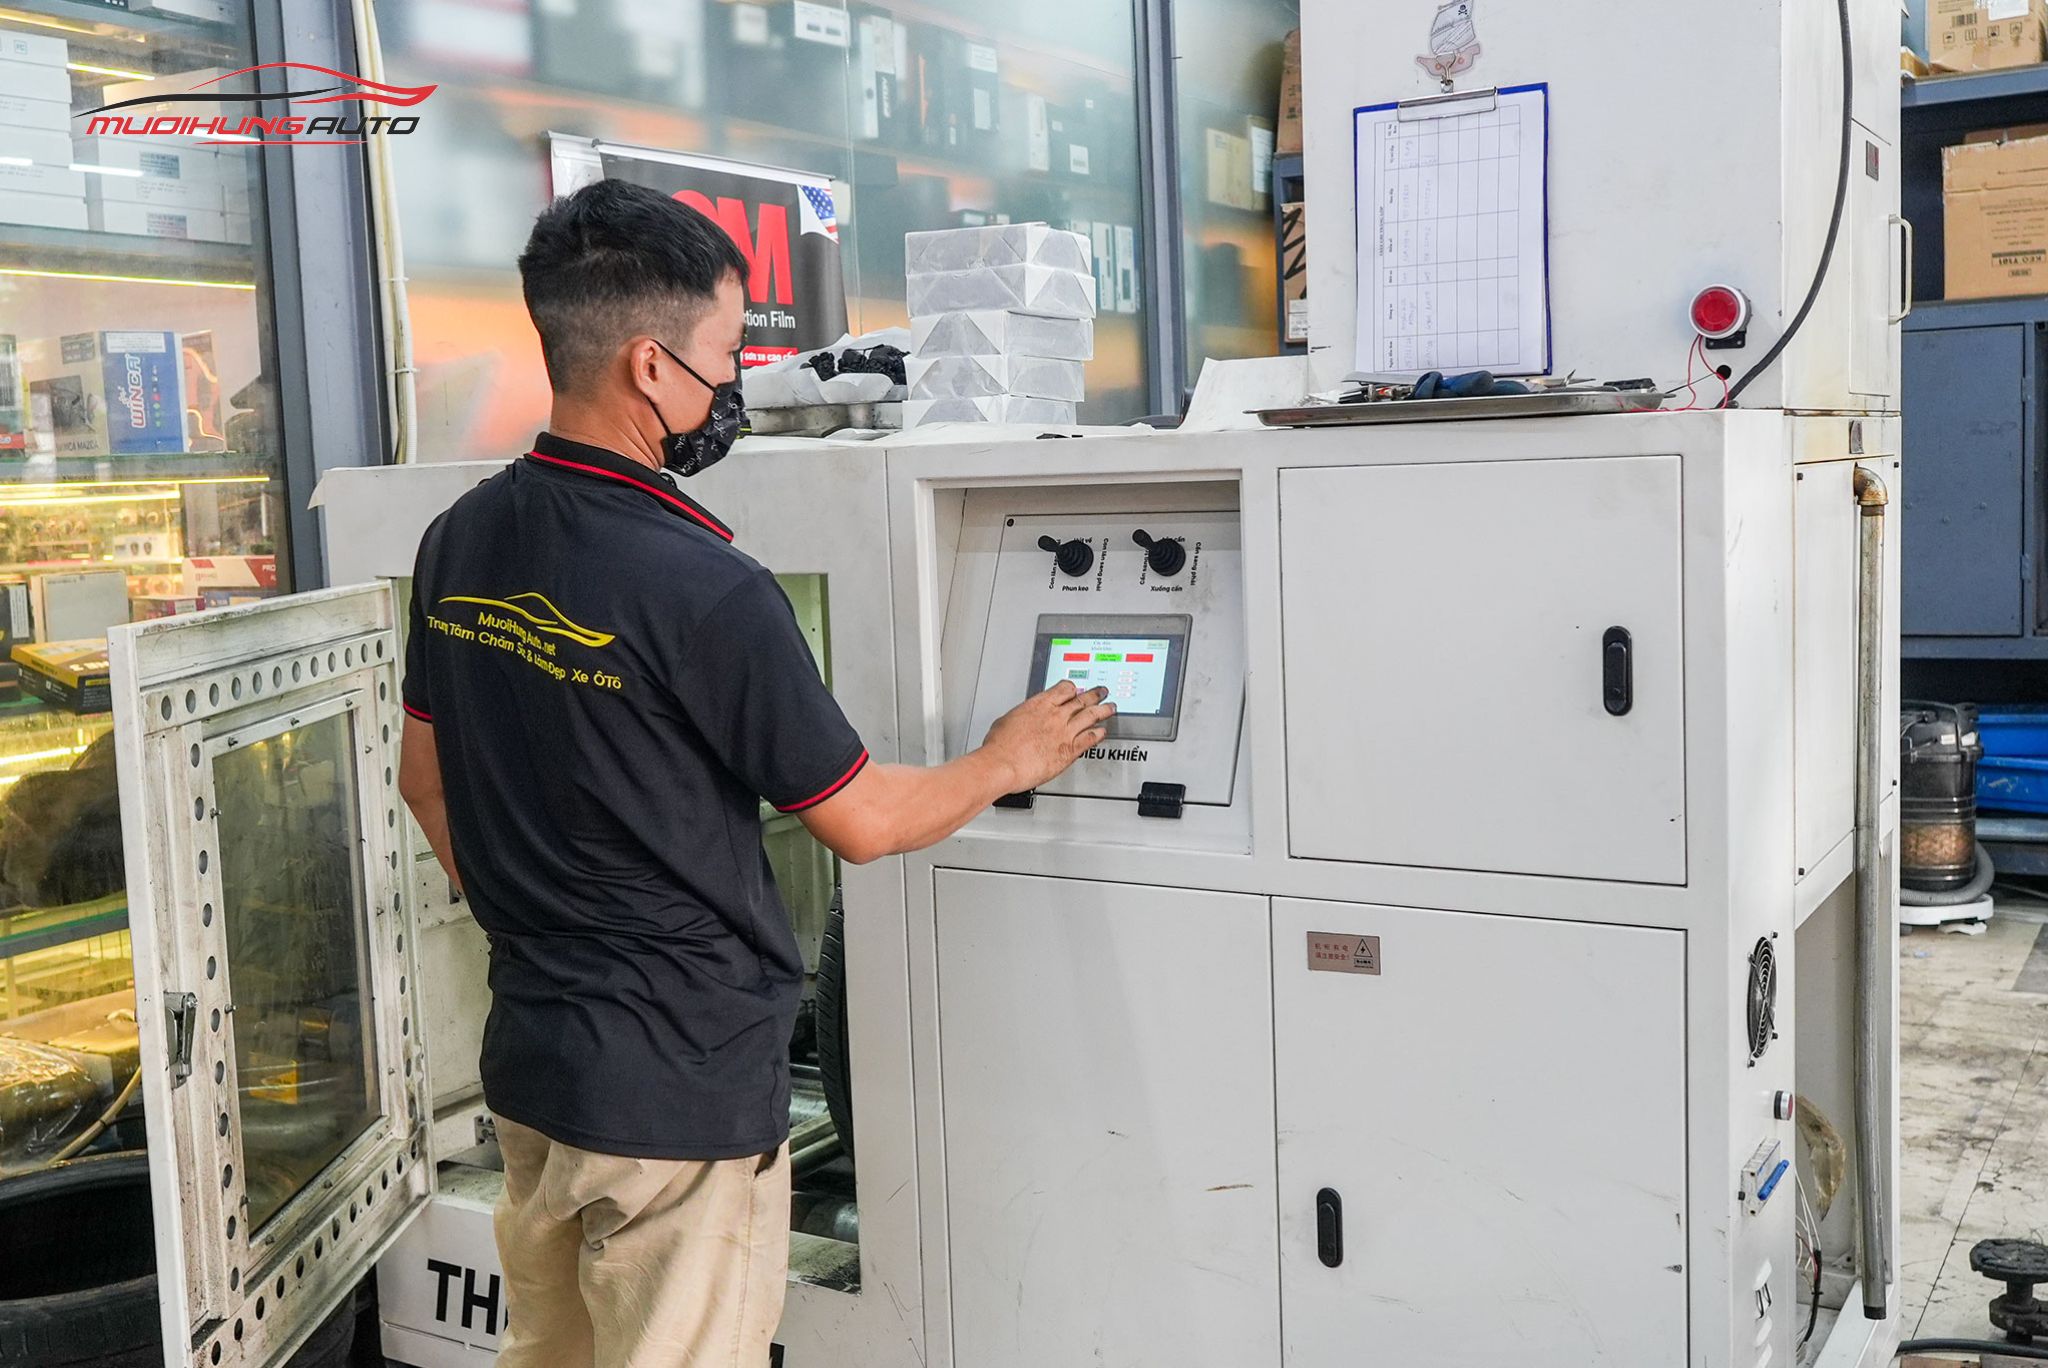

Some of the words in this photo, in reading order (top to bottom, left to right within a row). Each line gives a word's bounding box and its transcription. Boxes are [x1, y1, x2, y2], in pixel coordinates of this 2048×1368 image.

[745, 309, 767, 328] tion
[770, 310, 796, 329] Film
[449, 622, 475, 641] Tâm
[478, 631, 515, 651] Chăm
[527, 649, 534, 663] &
[571, 668, 589, 683] Xe
[593, 670, 622, 690] ÔTô
[1108, 745, 1148, 762] KHIỂN
[427, 1258, 508, 1336] TH
